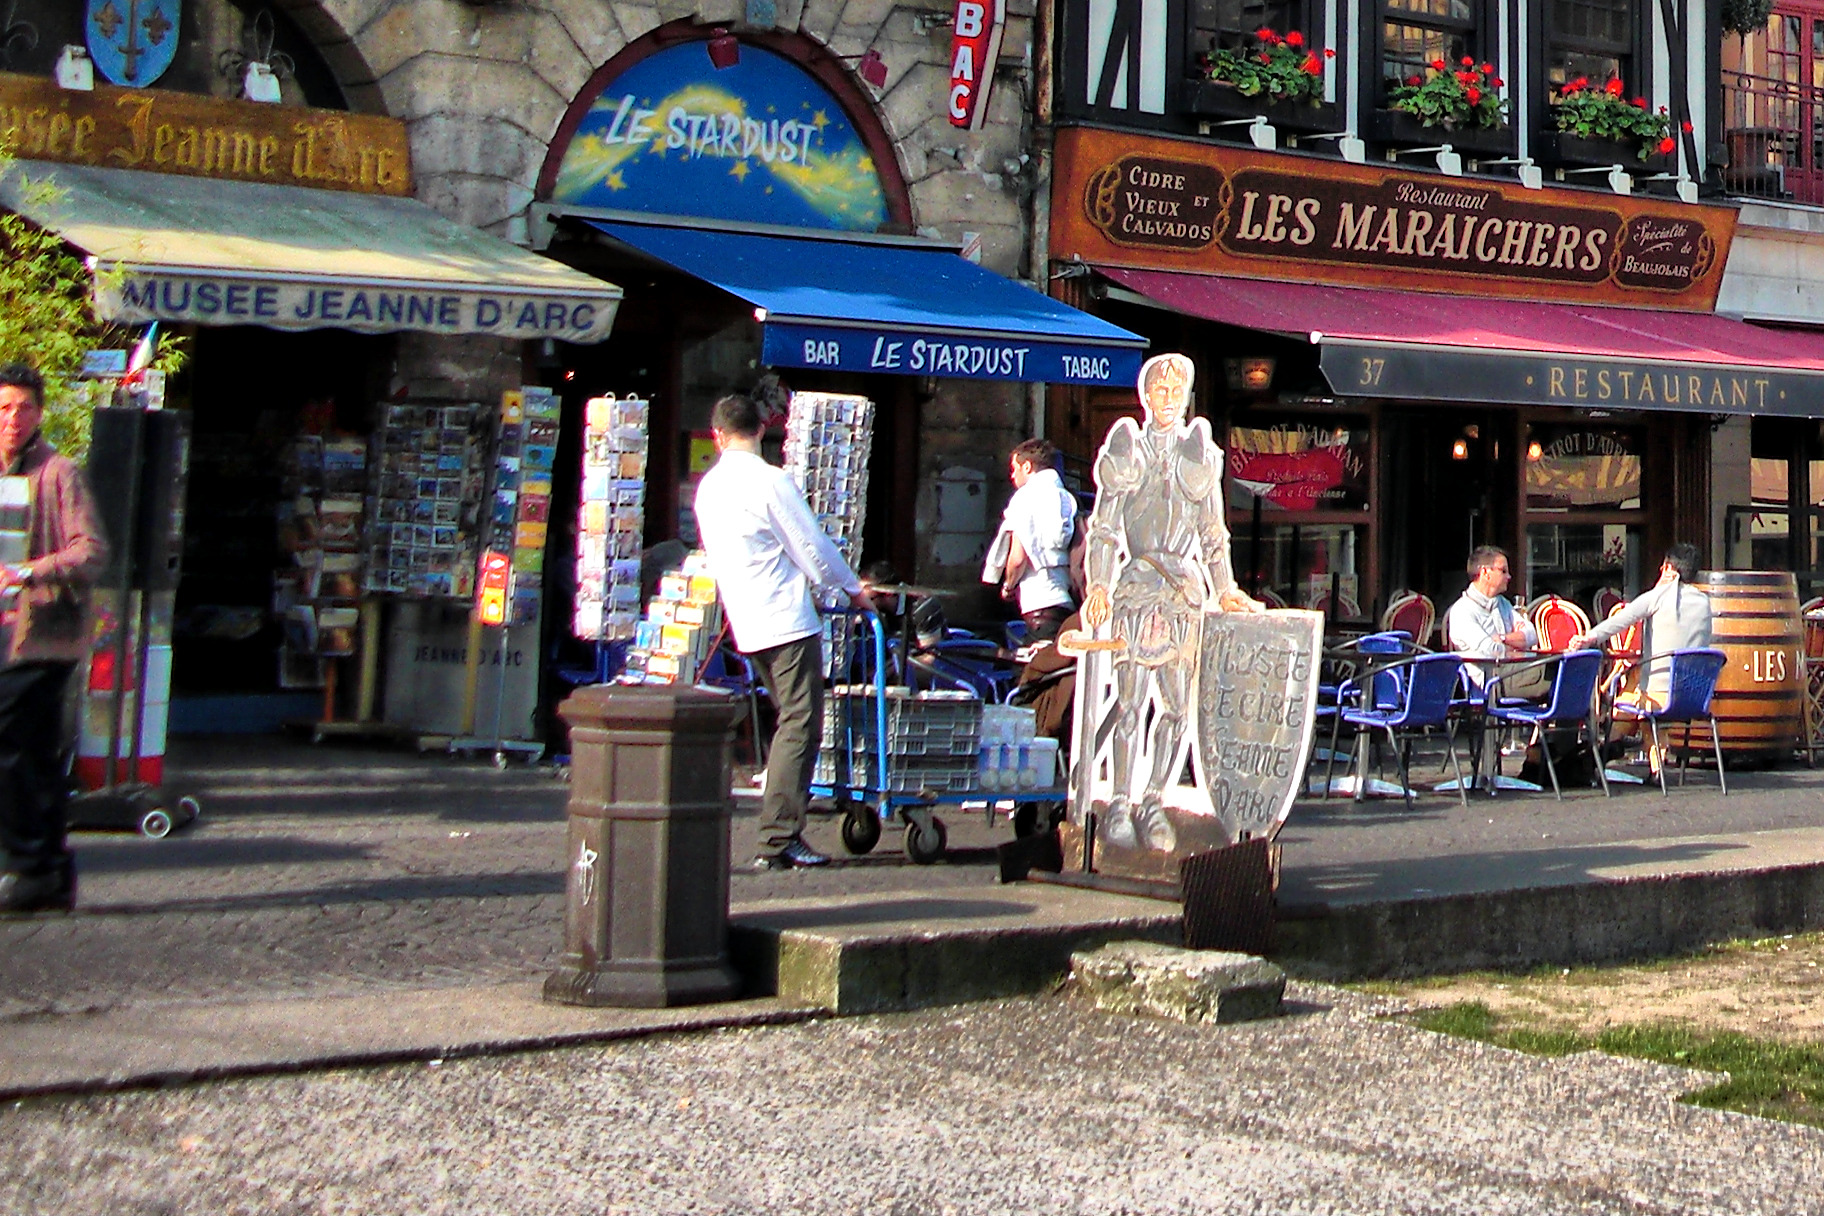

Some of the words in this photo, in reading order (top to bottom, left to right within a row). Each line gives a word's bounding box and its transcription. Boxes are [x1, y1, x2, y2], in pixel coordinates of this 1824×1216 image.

[0, 97, 96, 156] usée
[106, 93, 280, 175] Jeanne
[605, 94, 656, 145] LE
[665, 106, 817, 166] STARDUST
[1395, 183, 1490, 211] Restaurant
[1235, 191, 1321, 245] LES
[1332, 201, 1608, 272] MARAICHERS
[1680, 241, 1692, 254] de
[120, 279, 280, 317] MUSEE
[294, 289, 463, 327] JEANNE
[475, 298, 596, 331] D'ARC
[804, 339, 840, 365] BAR
[870, 336, 903, 369] LE
[909, 338, 1030, 378] STARDUST
[1062, 355, 1111, 380] TABAC
[1359, 358, 1385, 386] 37
[1549, 367, 1770, 408] RESTAURANT
[1753, 650, 1786, 682] LES
